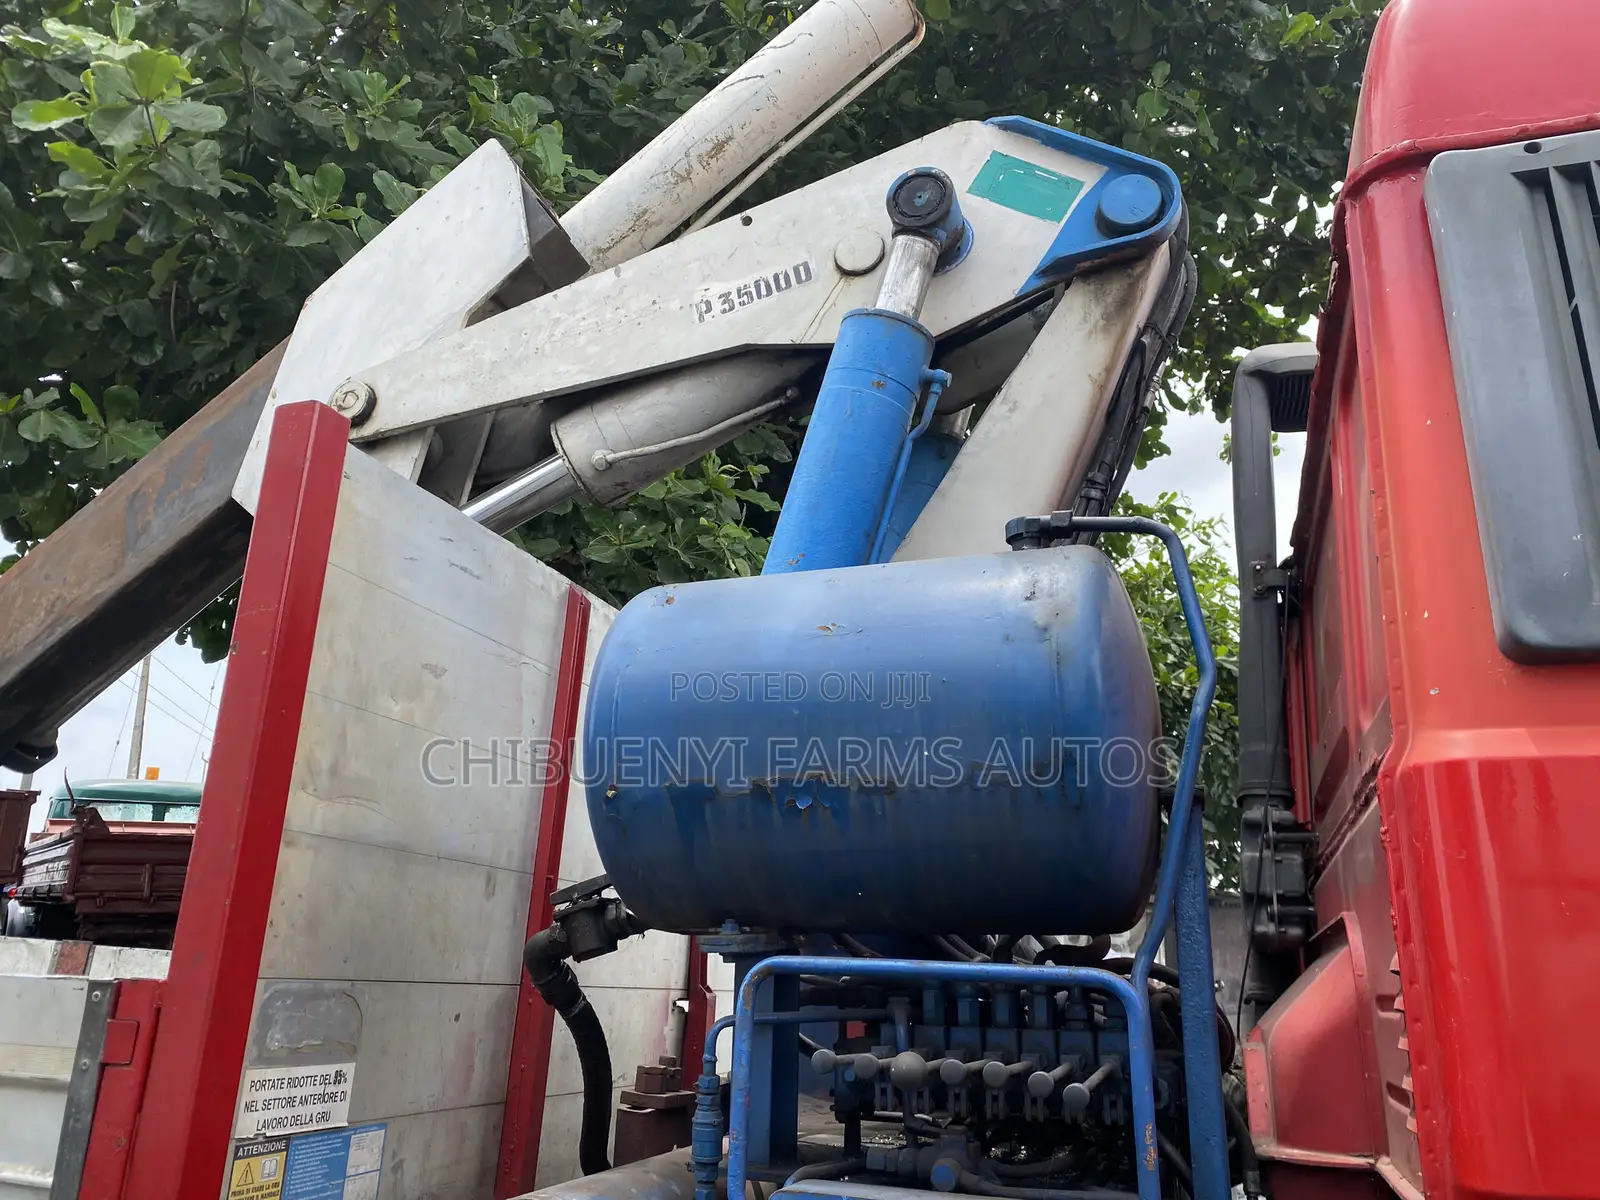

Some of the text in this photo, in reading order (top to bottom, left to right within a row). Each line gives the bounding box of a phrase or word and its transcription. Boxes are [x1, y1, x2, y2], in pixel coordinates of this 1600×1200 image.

[249, 1077, 286, 1092] PORTATE
[286, 1074, 318, 1089] RIDOTTE
[319, 1073, 332, 1086] DEL
[243, 1090, 347, 1113] NEL SETTORE ANTERIORE DI
[256, 1110, 332, 1131] LAVORO DELLA GRU
[237, 1140, 287, 1157] ATTENZIONE
